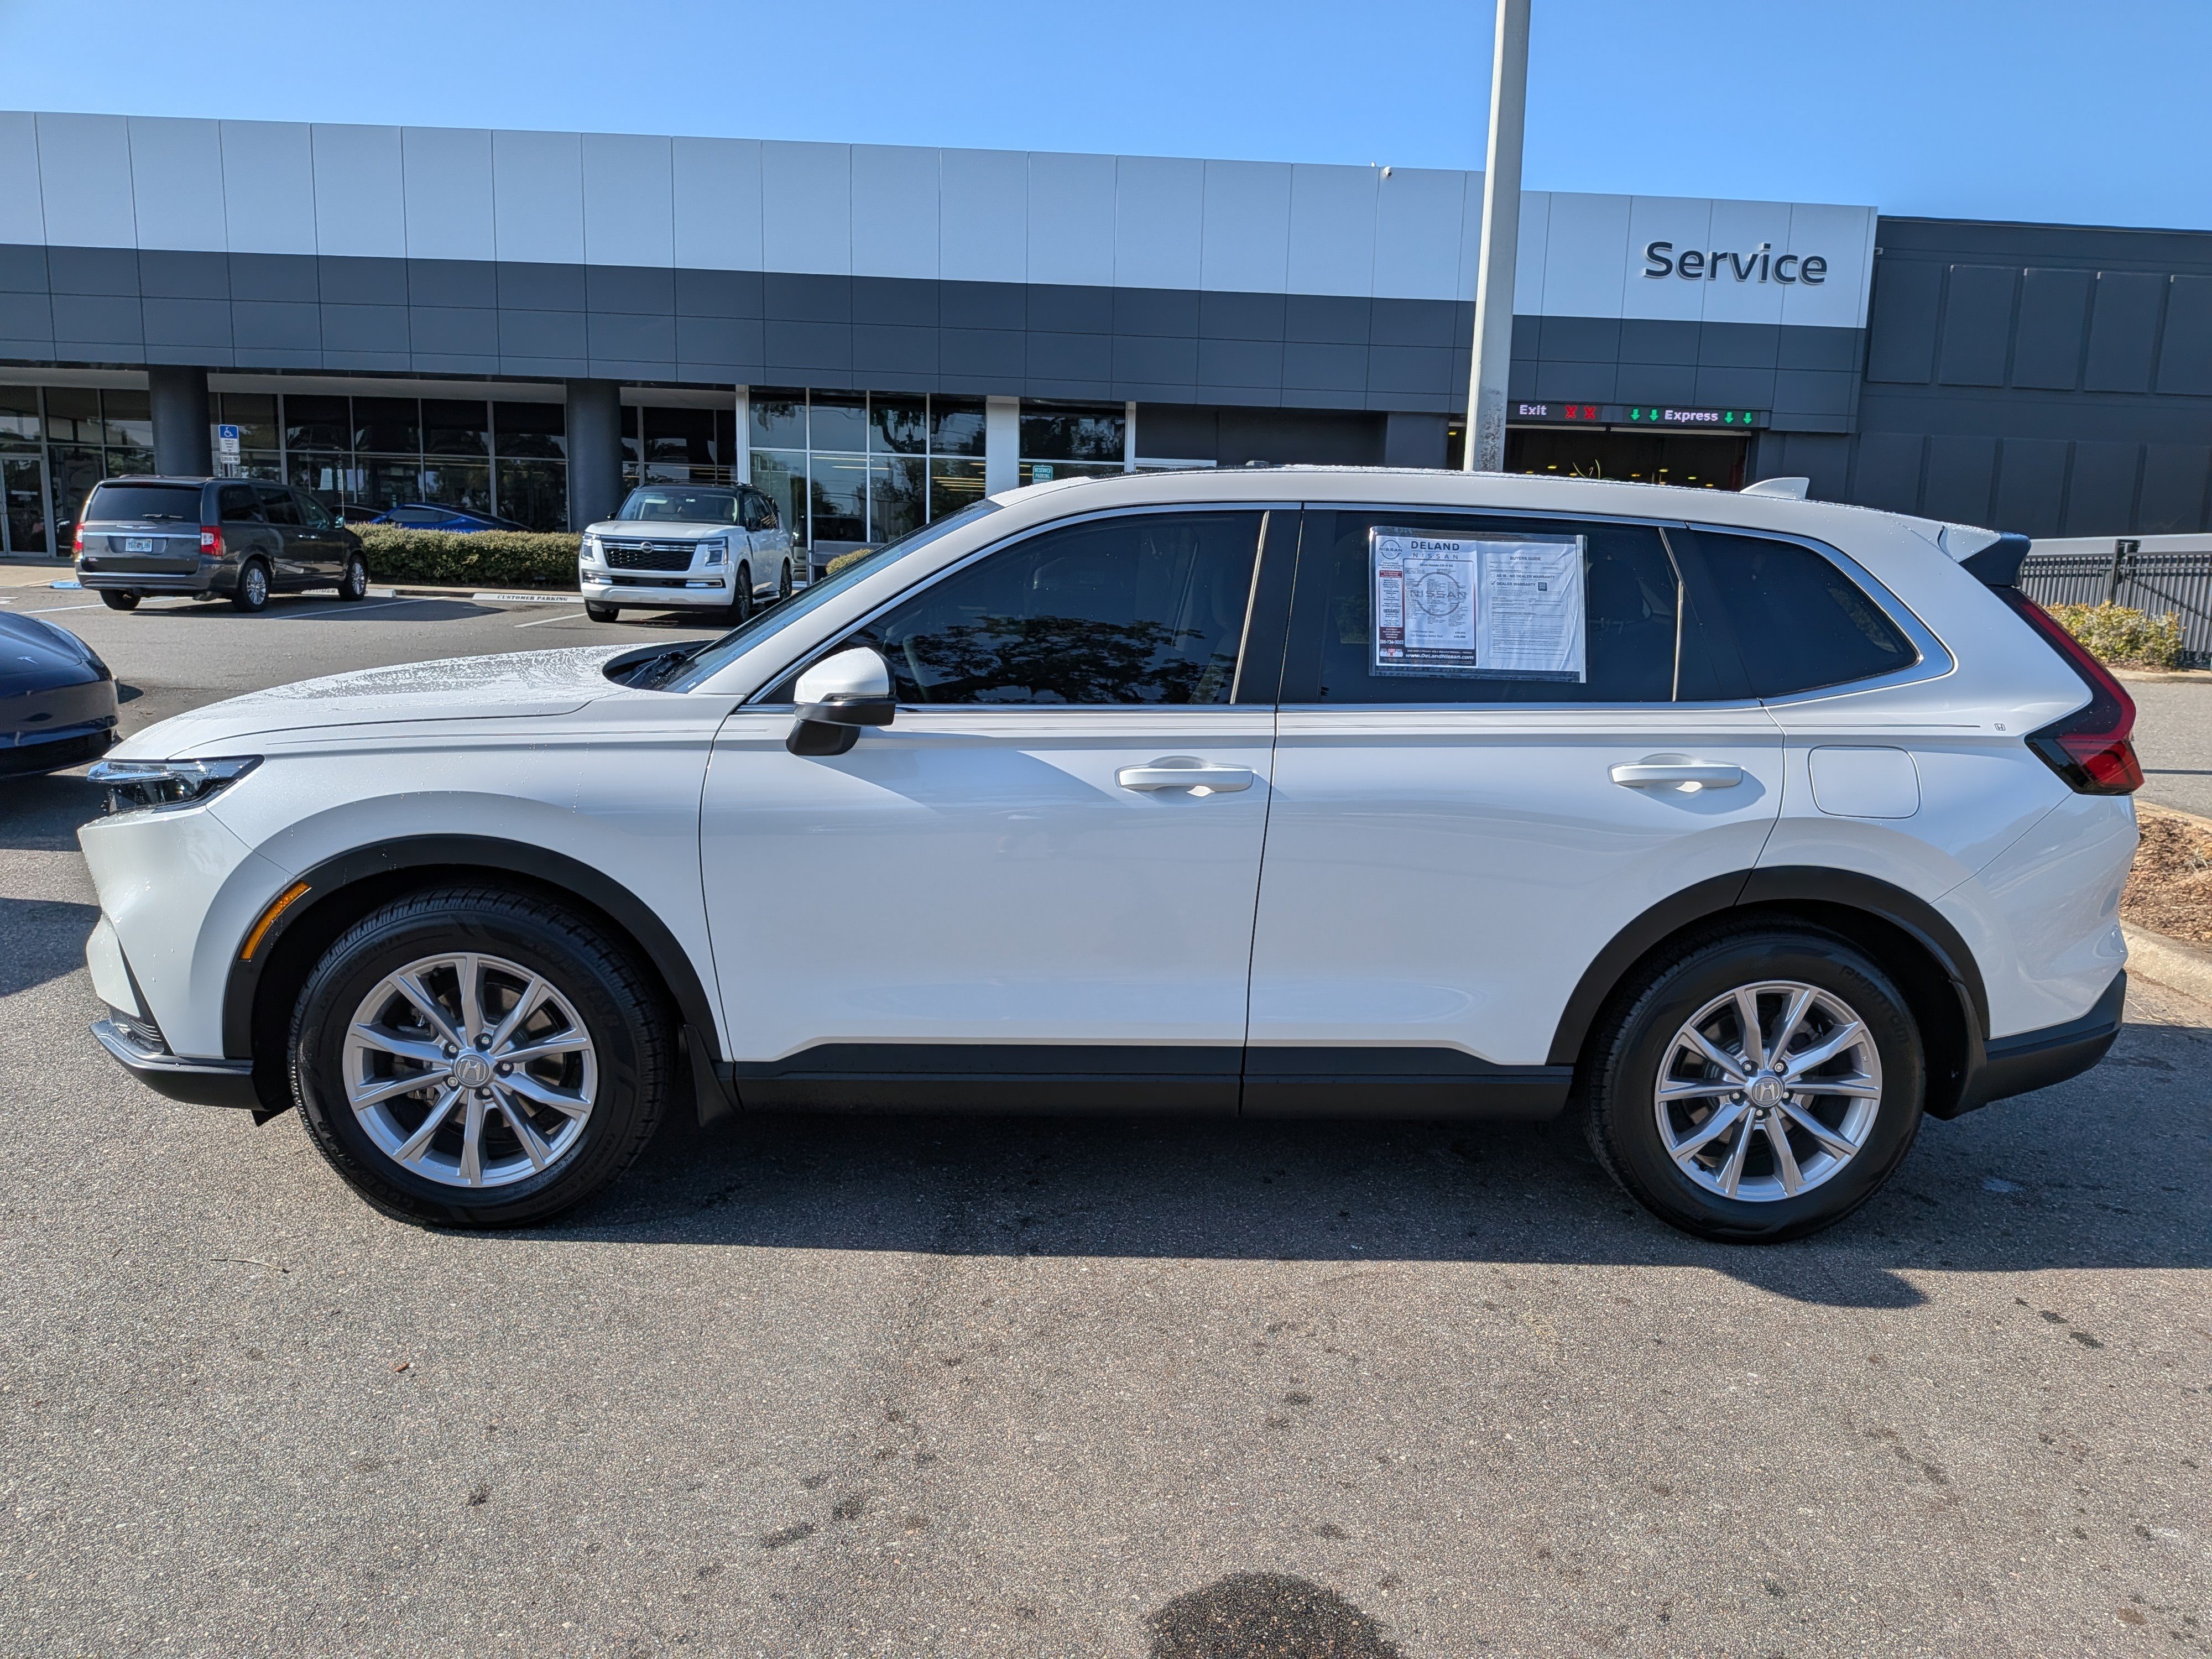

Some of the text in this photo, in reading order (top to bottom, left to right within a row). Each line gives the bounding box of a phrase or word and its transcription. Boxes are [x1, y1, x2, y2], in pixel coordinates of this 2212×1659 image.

[1644, 241, 1828, 285] Service
[1519, 404, 1547, 416] Exit
[1664, 410, 1719, 423] Express
[1411, 541, 1460, 551] DELAND
[1410, 589, 1467, 598] NISSAN
